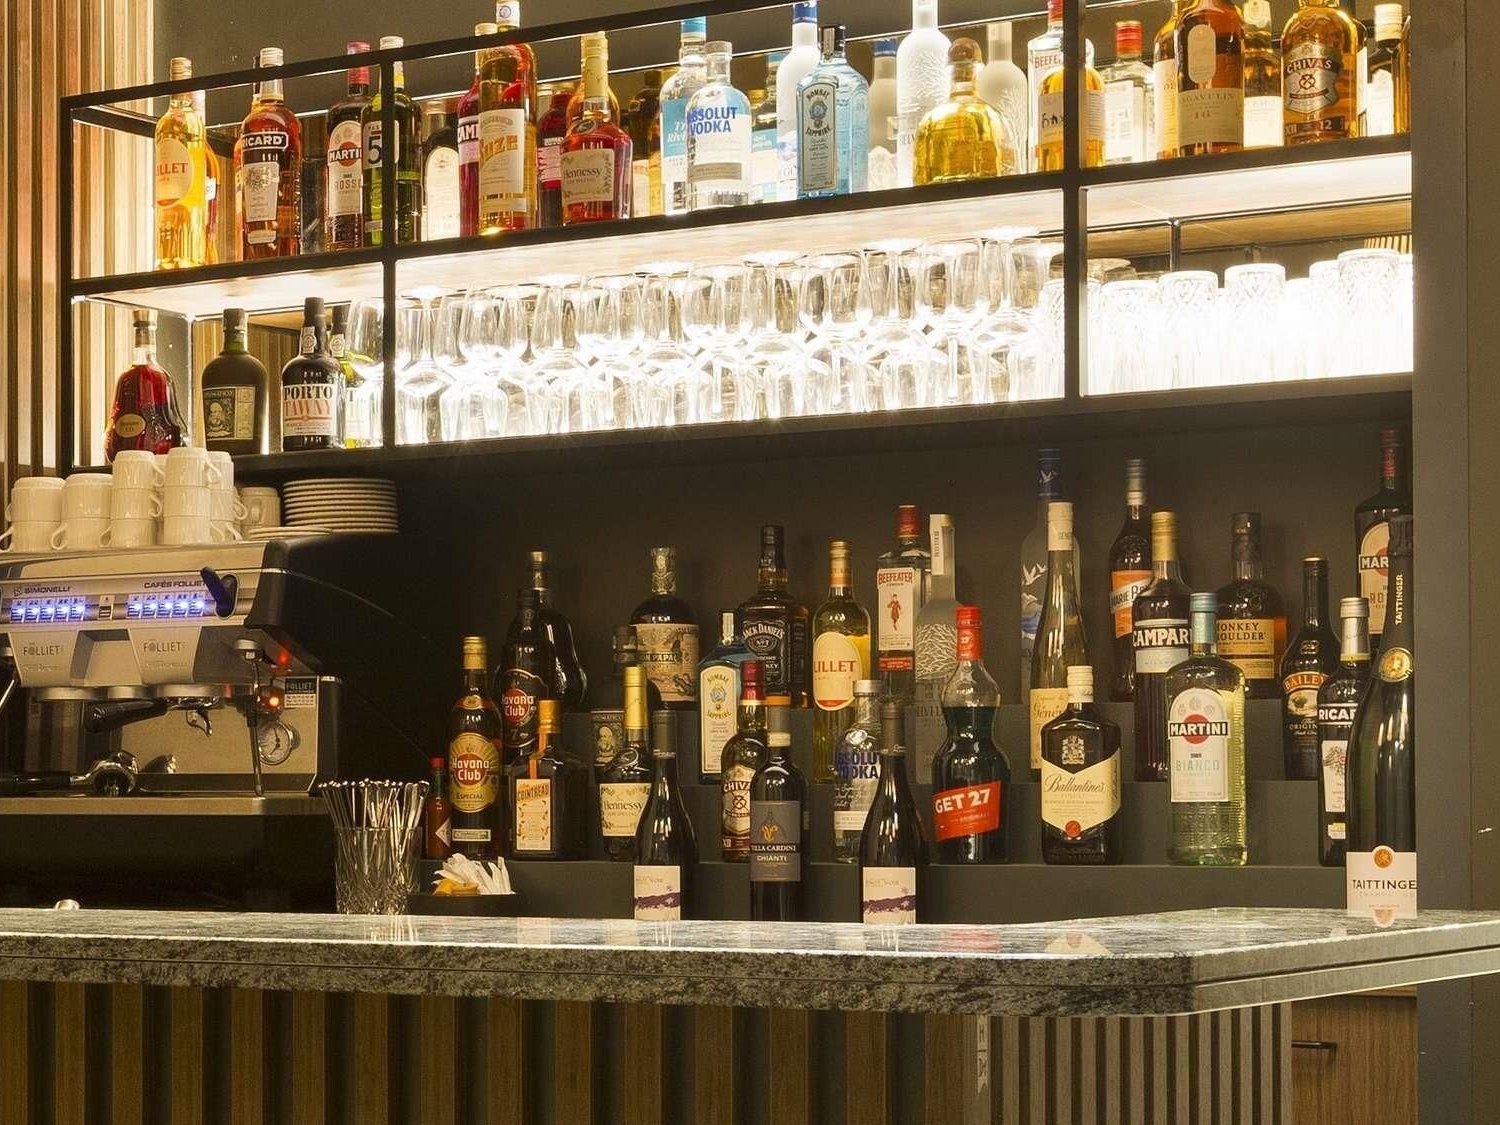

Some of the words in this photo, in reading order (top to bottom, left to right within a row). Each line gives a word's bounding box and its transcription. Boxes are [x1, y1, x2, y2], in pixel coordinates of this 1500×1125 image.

[1035, 55, 1061, 69] BEEFE
[1286, 58, 1333, 74] CHIVAS
[687, 106, 738, 125] ABSOLUT
[690, 119, 732, 136] VODKA
[1319, 120, 1332, 131] 12
[329, 148, 363, 161] MARTI
[157, 162, 189, 176] ILLET
[284, 385, 333, 401] PORTO
[284, 400, 332, 416] TAWNY
[878, 571, 914, 586] BEEFEATER
[24, 585, 71, 595] SIMONELLI
[1395, 573, 1404, 625] TAITTINGER
[742, 625, 758, 639] JACK
[1217, 622, 1259, 632] ONKEY
[1133, 628, 1191, 647] CAMPAR
[1217, 632, 1264, 641] OULDER
[23, 645, 60, 657] FOLLIET
[143, 641, 181, 653] FOLLIET
[1284, 674, 1324, 690] BAILE
[504, 705, 526, 717] Club
[1318, 708, 1357, 721] RICA
[1170, 722, 1227, 736] MARTINI
[452, 757, 490, 769] Havana
[1175, 760, 1220, 772] BIANCO
[457, 769, 481, 780] Club
[723, 781, 751, 792] CHIVA
[1044, 773, 1105, 793] Ballantine's
[935, 793, 965, 814] GET
[968, 788, 991, 807] 27
[1352, 879, 1418, 890] TAITTINGE
